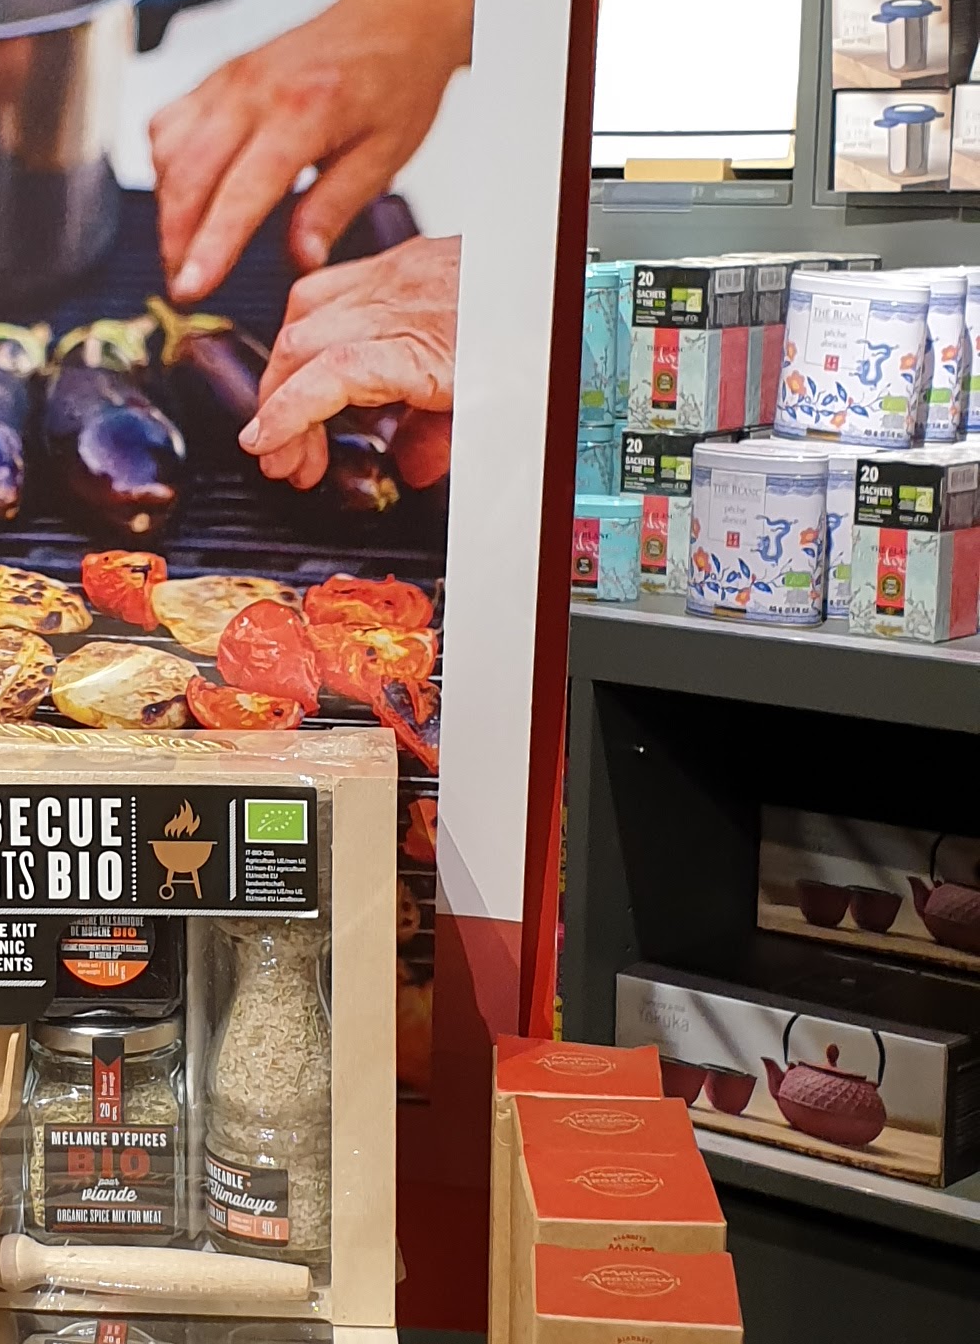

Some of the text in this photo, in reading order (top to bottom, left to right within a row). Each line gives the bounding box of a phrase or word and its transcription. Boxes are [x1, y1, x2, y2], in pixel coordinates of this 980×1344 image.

[638, 271, 654, 286] 20
[636, 290, 666, 299] SACHETS
[813, 307, 863, 322] THÉ BLANC
[626, 439, 642, 453] 20
[626, 457, 655, 466] SACHETS
[861, 466, 879, 482] 20
[713, 482, 762, 496] THÉ BLANC
[860, 486, 893, 496] SACHETS
[47, 851, 122, 901] BIO
[12, 922, 37, 938] KIT
[51, 1131, 167, 1147] MÉLANGE D'ÉPICES
[67, 1148, 150, 1178] BIO
[81, 1187, 137, 1202] viande
[57, 1210, 161, 1223] ORGANIC MEAT
